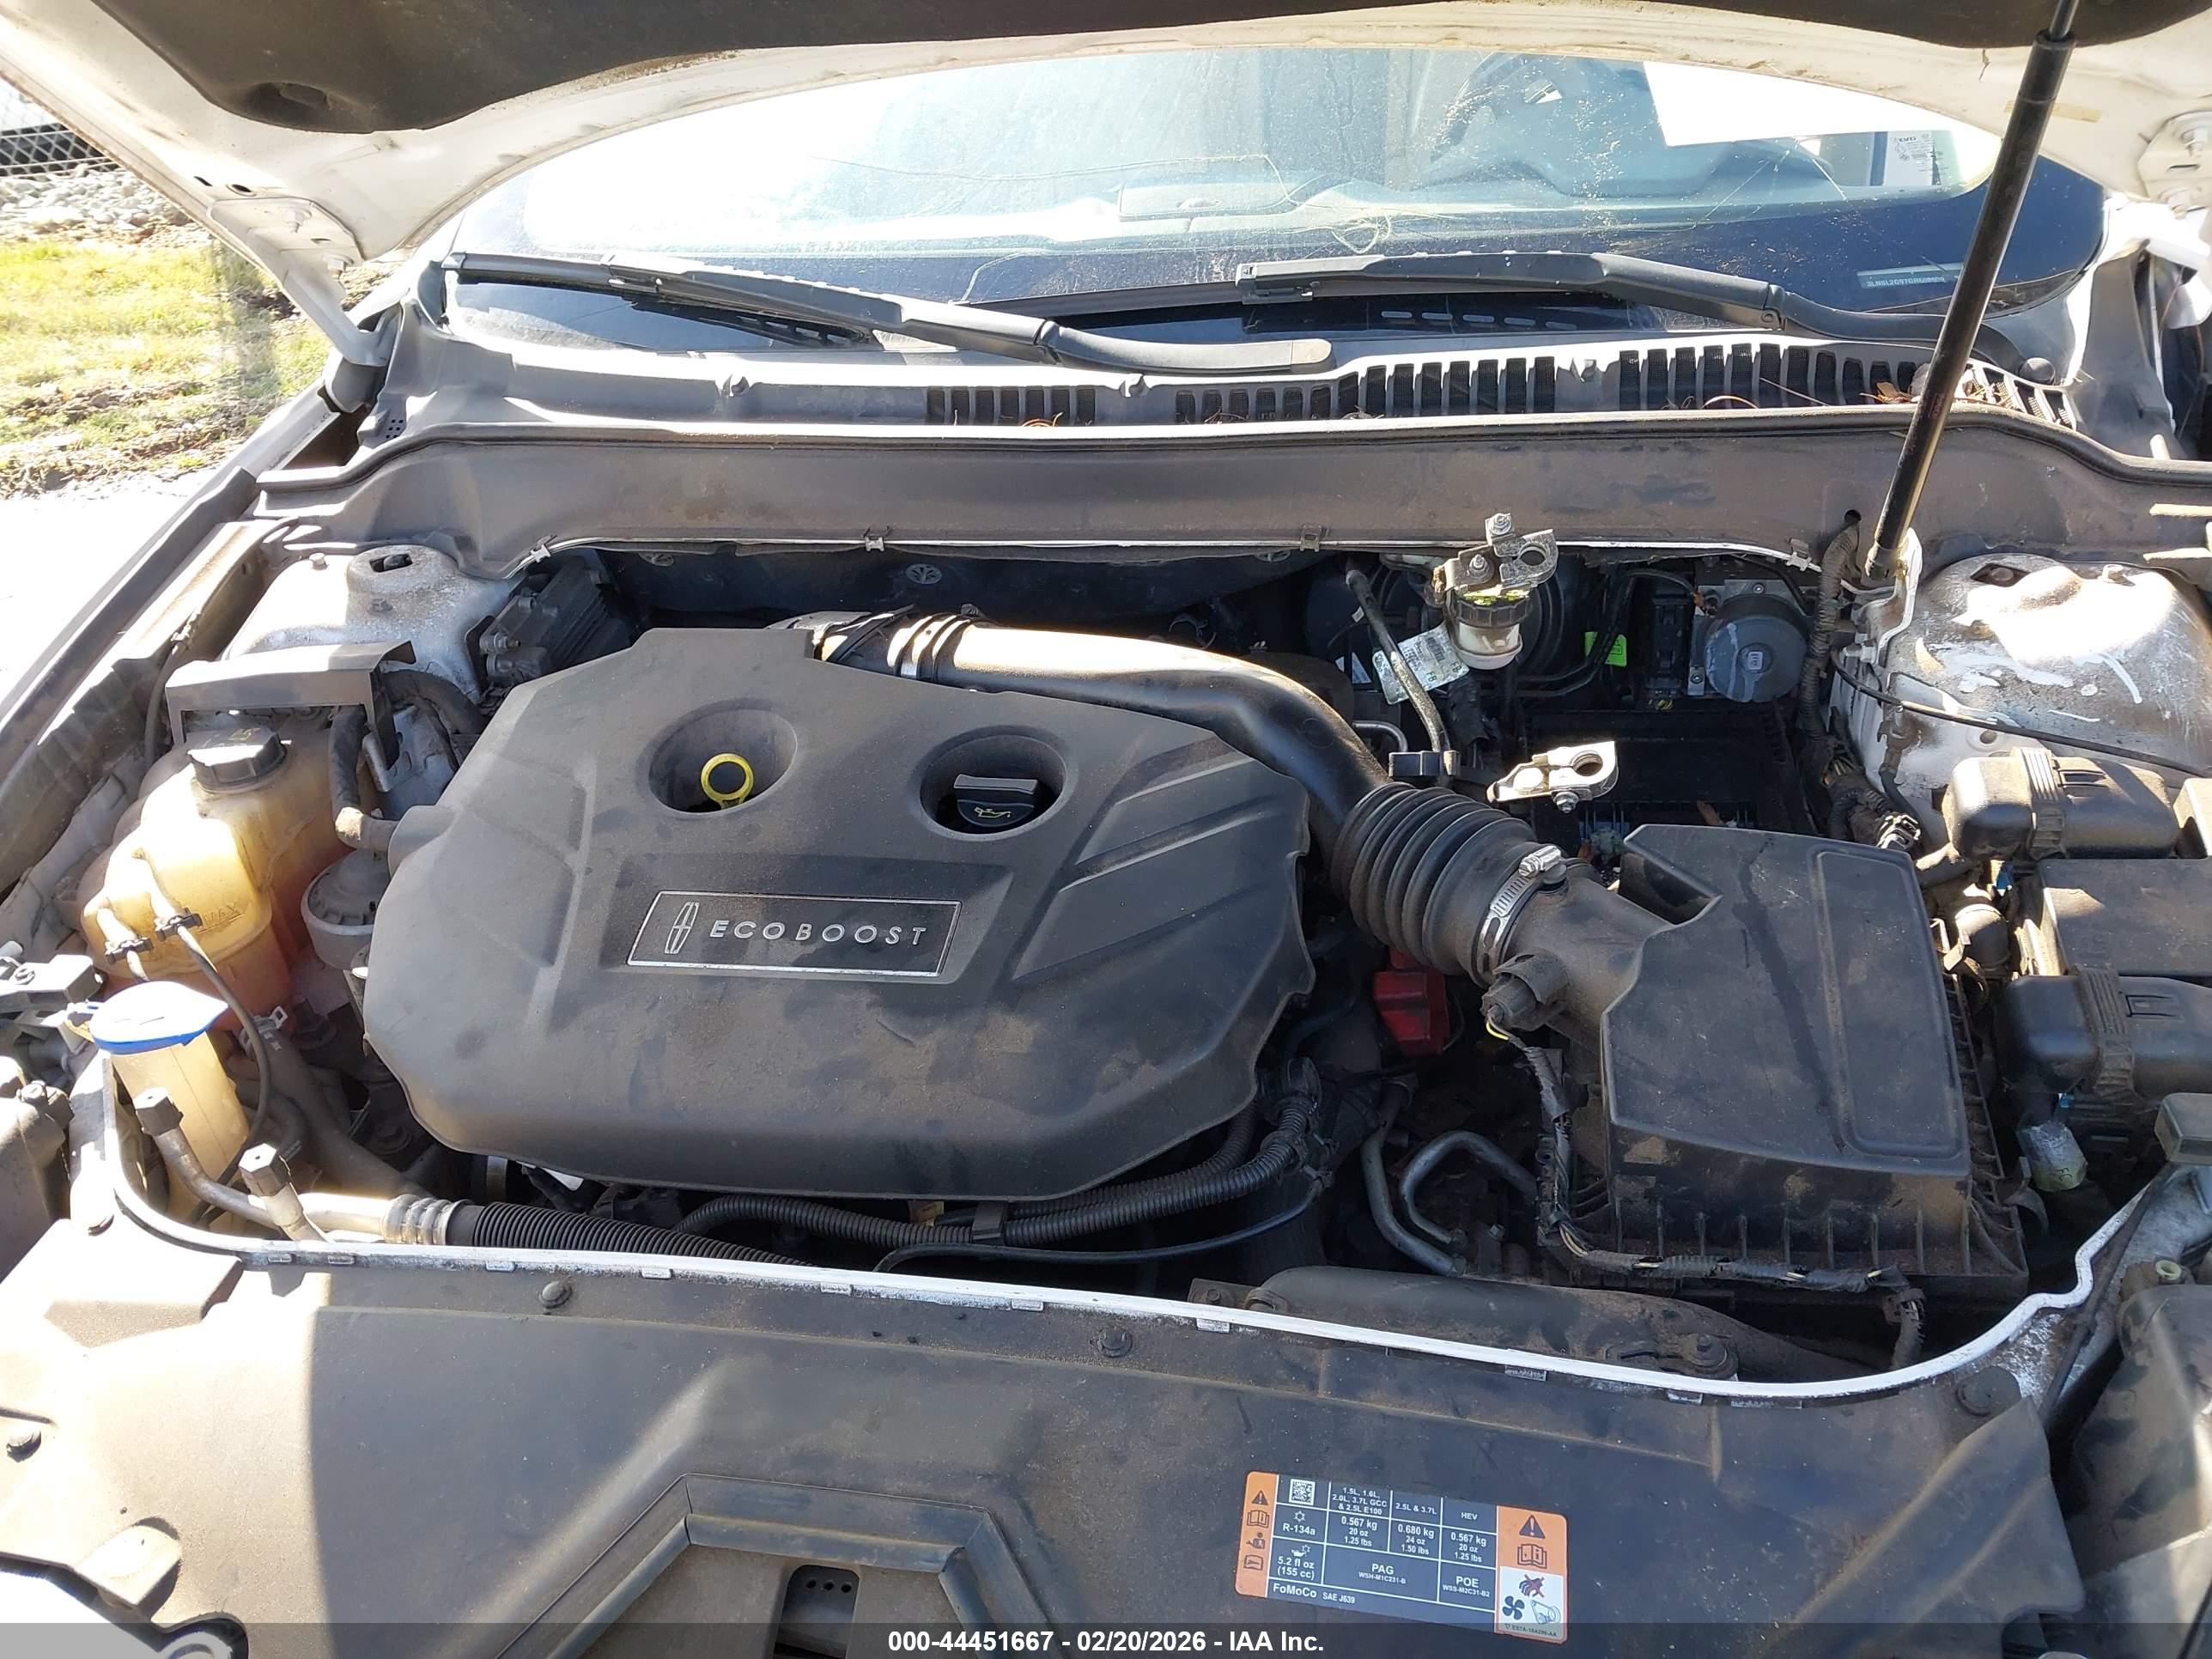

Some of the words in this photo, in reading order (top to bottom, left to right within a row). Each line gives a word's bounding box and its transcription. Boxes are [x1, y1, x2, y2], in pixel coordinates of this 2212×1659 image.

[709, 920, 927, 945] ECOBOOST
[1343, 1487, 1360, 1496] 1.5L,
[1363, 1490, 1381, 1498] 1.6L,
[1333, 1494, 1351, 1503] 2.0L,
[1352, 1497, 1368, 1505] 3.7L
[1370, 1499, 1388, 1508] GCC
[1364, 1507, 1382, 1516] E100
[1395, 1503, 1411, 1511] 2.5L
[1421, 1506, 1437, 1515] 3.7L
[1461, 1512, 1478, 1521] HEV
[1283, 1523, 1316, 1535] R-134a
[1341, 1516, 1364, 1527] 0.567
[1367, 1518, 1378, 1530] kg
[1398, 1524, 1421, 1535] 0.680
[1423, 1526, 1434, 1539] kg
[1345, 1535, 1359, 1545] 1.25
[1361, 1538, 1372, 1547] lbs
[1406, 1535, 1415, 1544] 24
[1451, 1532, 1474, 1543] 0.567
[1476, 1535, 1486, 1547] kg
[1401, 1544, 1416, 1553] 1.50
[1418, 1546, 1430, 1555] lbs
[1459, 1543, 1468, 1552] 20
[1278, 1556, 1291, 1565] 5.2
[1455, 1552, 1469, 1561] 1.25
[1471, 1553, 1482, 1563] lbs
[1277, 1565, 1297, 1577] (155
[1300, 1570, 1315, 1580] cc)
[1371, 1564, 1395, 1575] PAG
[1455, 1576, 1480, 1588] POE
[1273, 1583, 1317, 1598] FoMoCo
[1322, 1592, 1338, 1601] SAE
[1339, 1595, 1356, 1604] J639
